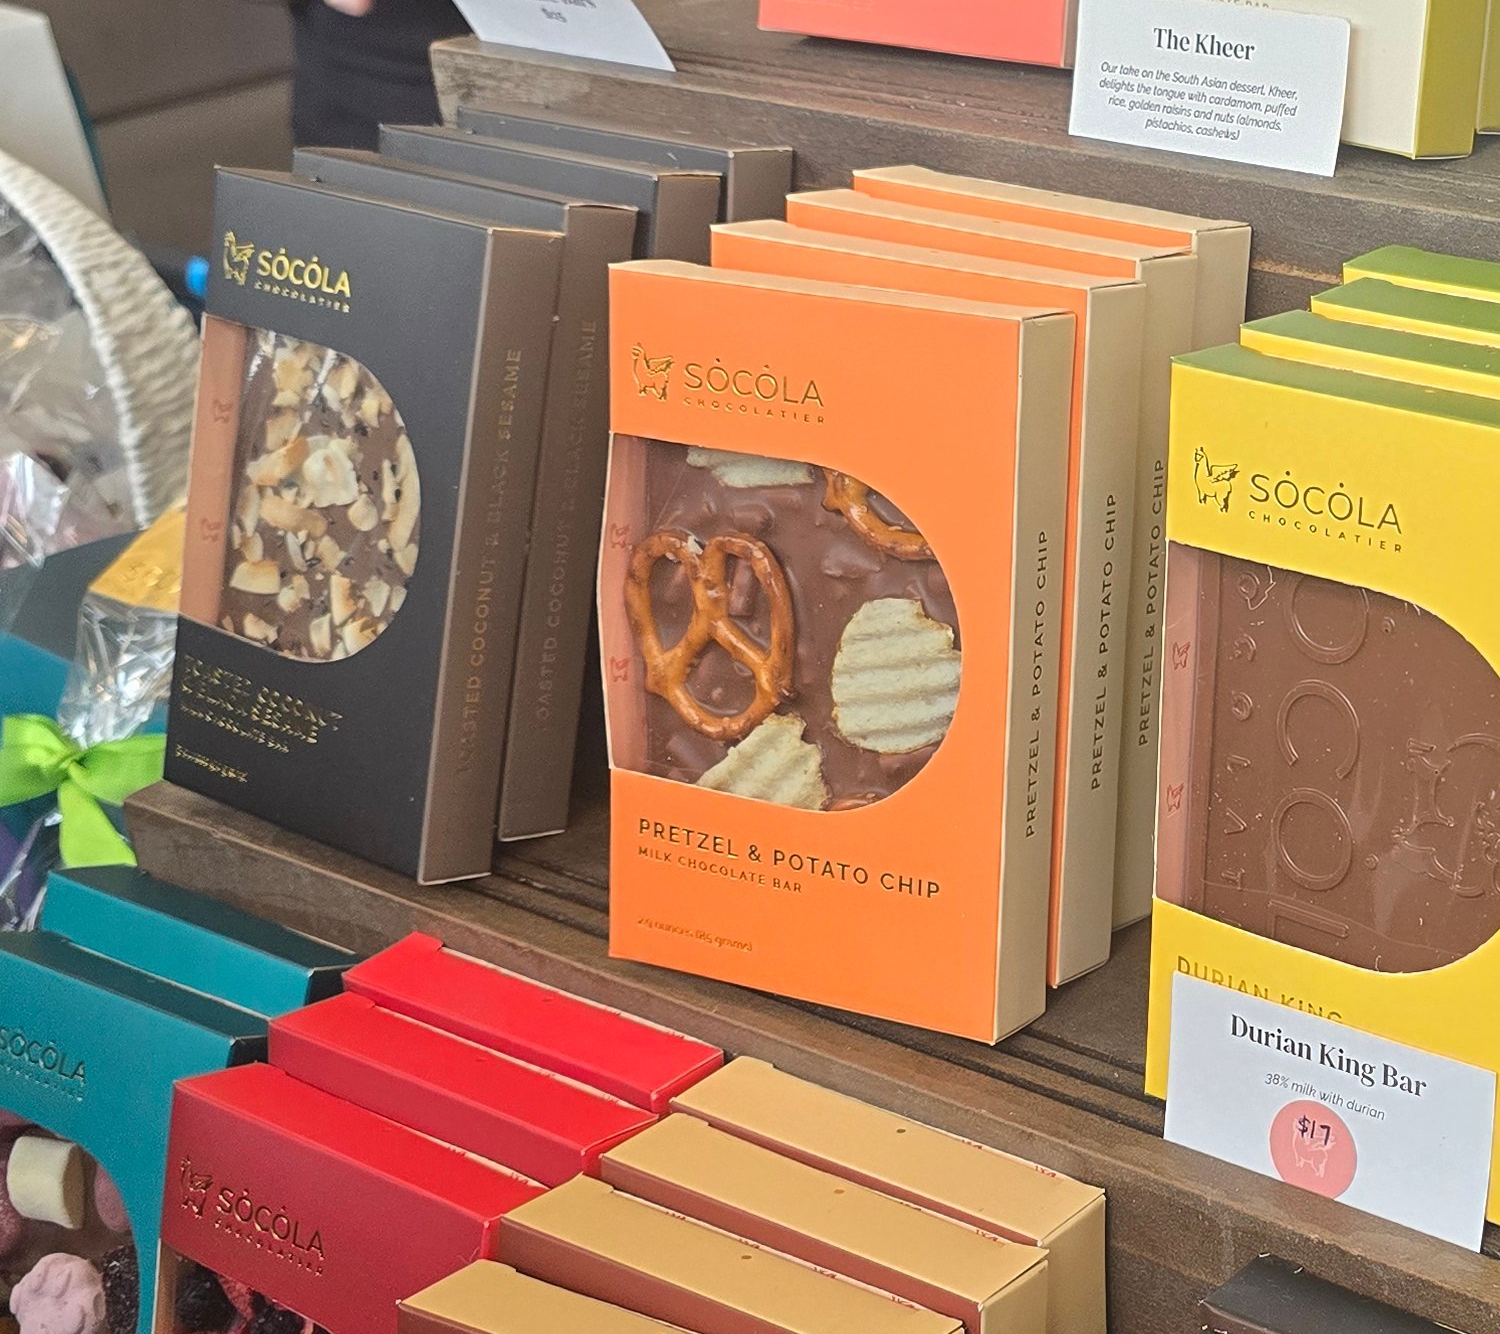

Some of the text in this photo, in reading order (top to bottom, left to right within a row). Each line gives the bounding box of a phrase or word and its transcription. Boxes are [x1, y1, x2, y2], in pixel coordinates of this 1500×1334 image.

[1152, 27, 1256, 62] The Kheer
[1099, 77, 1135, 93] delights
[1136, 83, 1152, 96] the
[1153, 85, 1186, 101] tongue
[1187, 91, 1207, 104] with
[1264, 103, 1298, 118] puffed
[1101, 61, 1118, 75] Our
[1119, 64, 1140, 78] take
[1141, 69, 1154, 79] on
[1155, 68, 1171, 82] the
[1171, 71, 1200, 87] South
[1200, 76, 1228, 91] Asian
[1127, 98, 1161, 113] golden
[1161, 104, 1192, 118] raisins
[1193, 109, 1213, 121] and
[1214, 112, 1235, 125] nuts
[682, 395, 825, 424] CHOCOLATIER
[1248, 510, 1402, 553] CHOCOLATIER
[1138, 458, 1165, 747] PRETZEL & POTATO CHIP
[1091, 493, 1117, 791] PRETZEL & POTATO CHIP
[1025, 530, 1049, 839] PRETZEL & POTATO CHIP
[638, 846, 802, 894] MILK CHOCOLATE BAR
[639, 818, 941, 899] PRETZEL & POTATO CHIP
[1230, 1013, 1427, 1098] Durian King Bar
[1264, 1072, 1386, 1121] 38% milk with durian
[1296, 1114, 1331, 1147] $17
